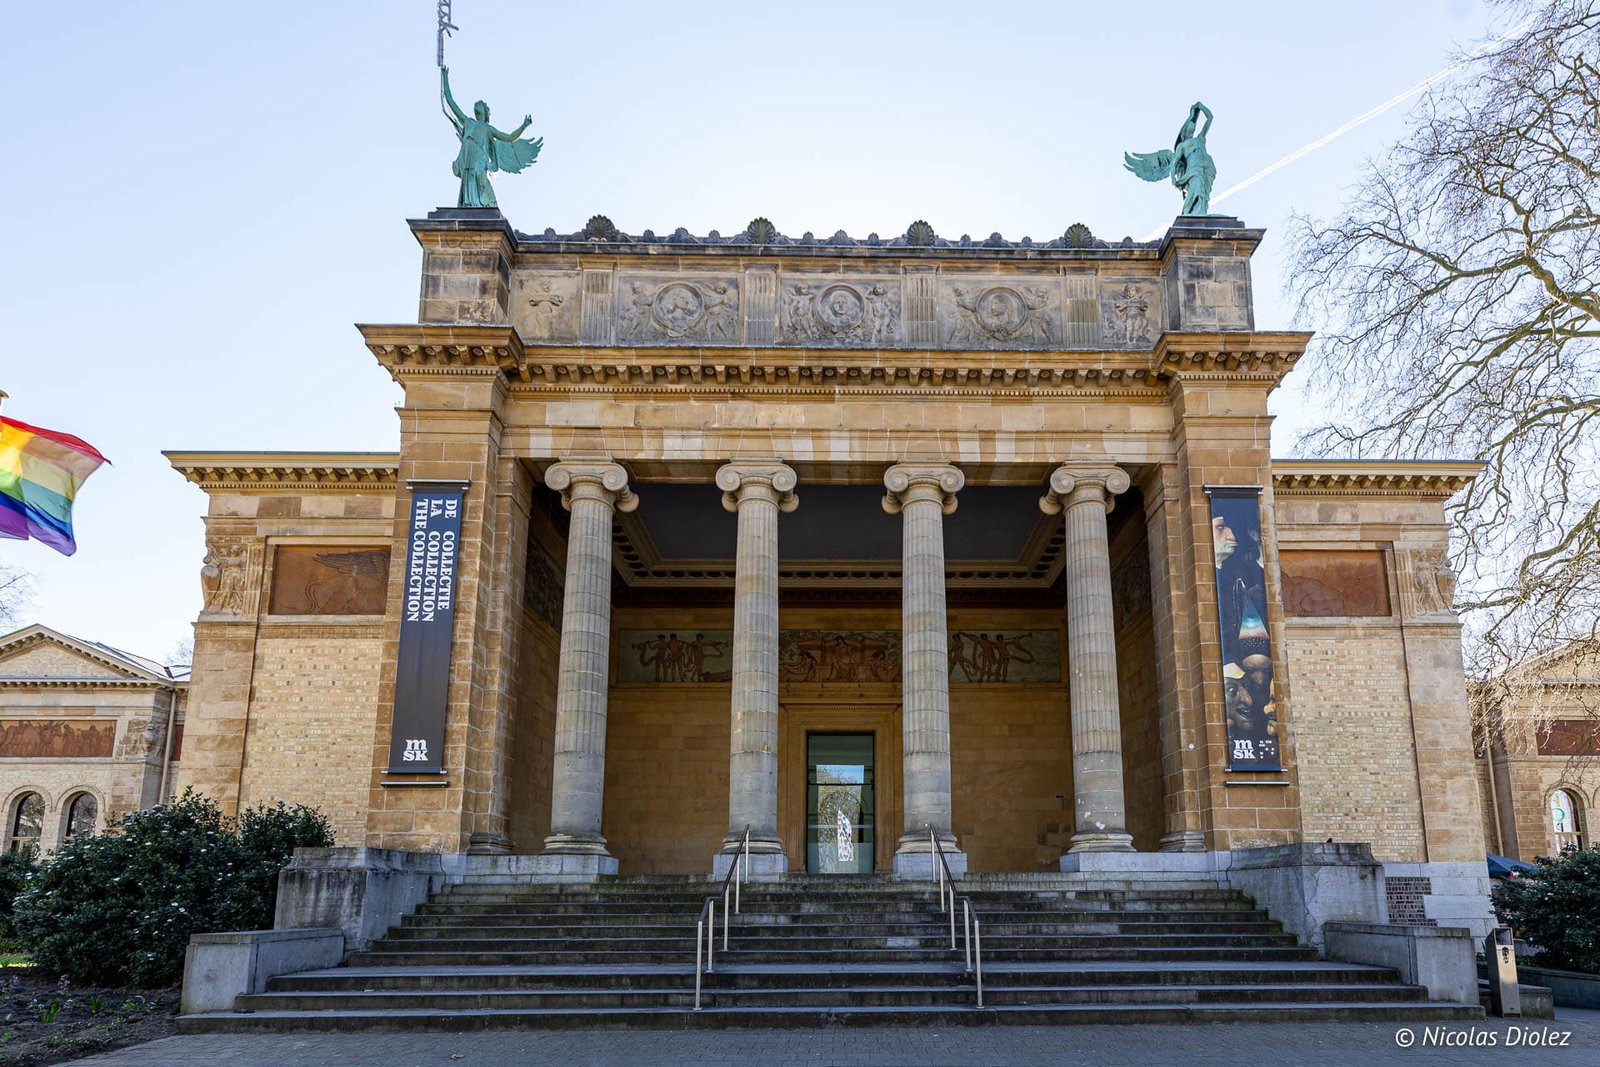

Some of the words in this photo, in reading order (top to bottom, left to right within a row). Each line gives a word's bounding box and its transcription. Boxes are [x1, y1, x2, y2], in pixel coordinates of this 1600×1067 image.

[415, 499, 428, 529] THE
[431, 499, 443, 517] LA
[445, 499, 457, 518] DE
[407, 531, 426, 621] COLLECTION
[422, 531, 440, 621] COLLECTION
[438, 531, 455, 610] COLLECTIE
